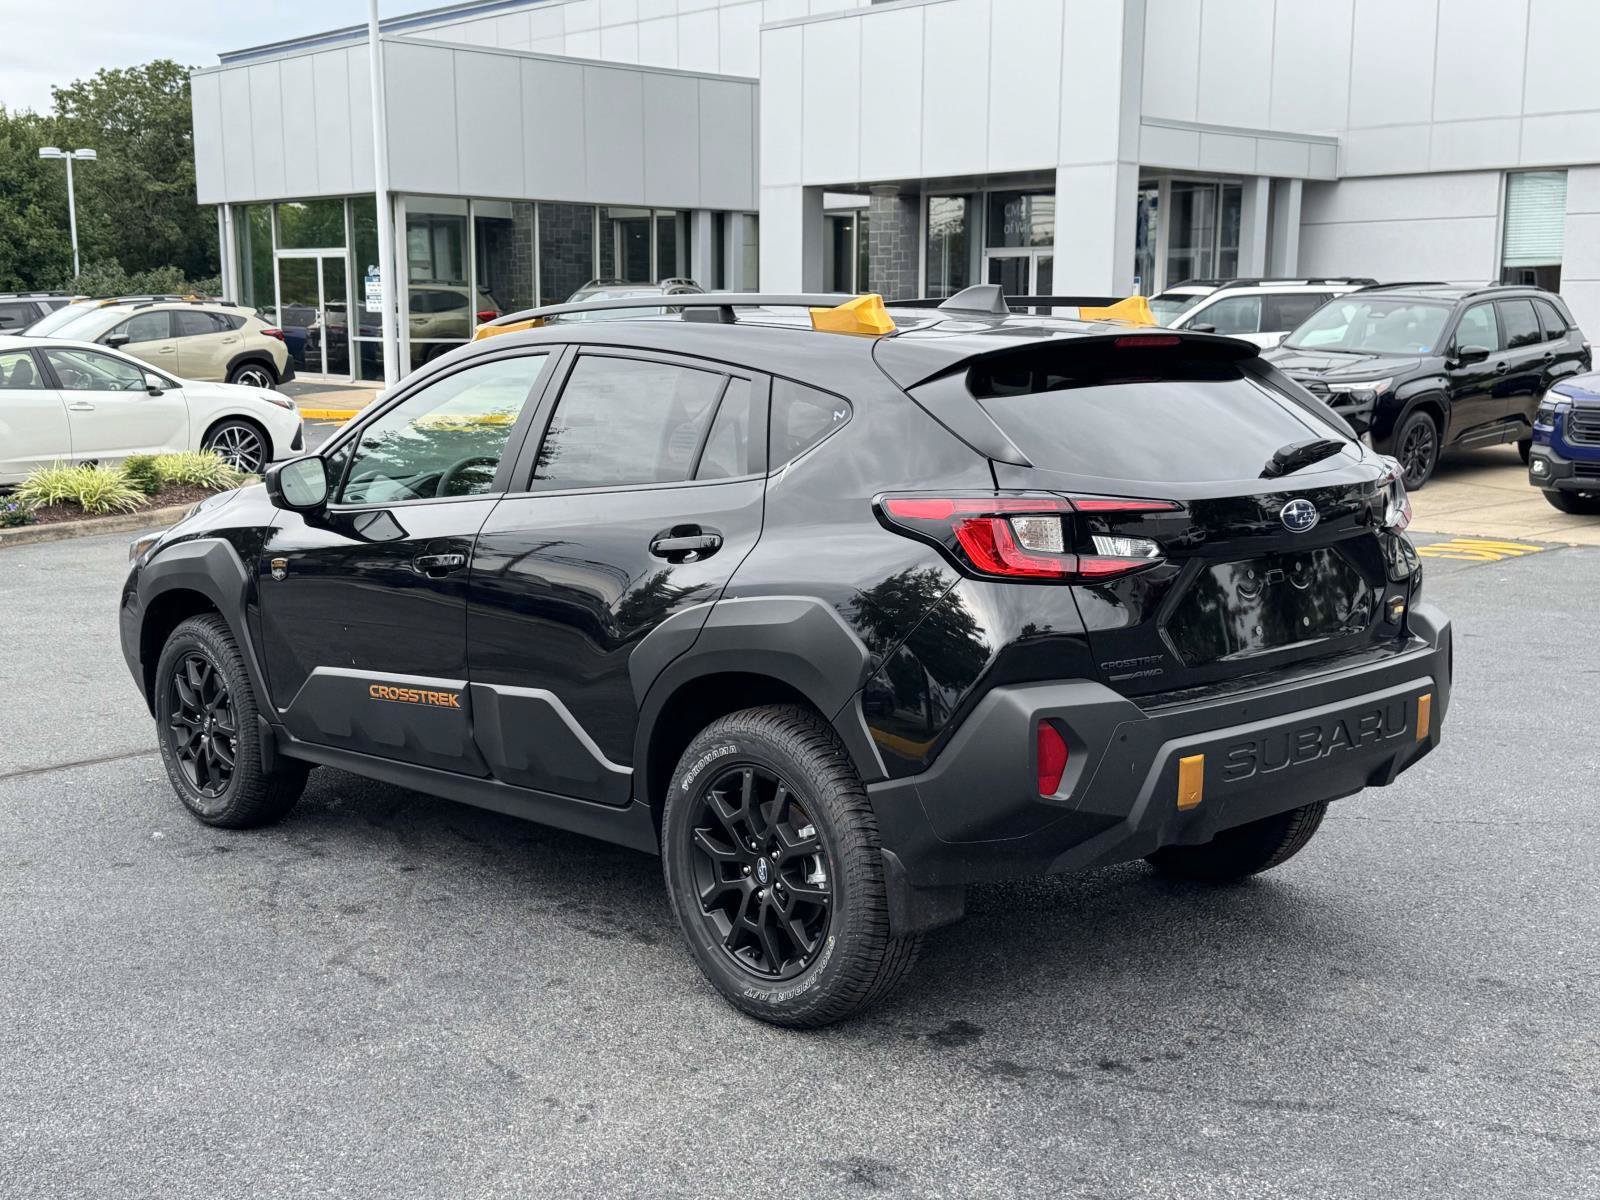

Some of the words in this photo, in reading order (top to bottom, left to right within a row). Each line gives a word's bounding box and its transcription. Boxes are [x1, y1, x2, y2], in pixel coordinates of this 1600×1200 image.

[1100, 654, 1164, 670] CROSSTREK
[369, 684, 461, 708] CROSSTREK
[1223, 701, 1408, 783] SUBARU
[681, 744, 737, 791] YOKOHAMA
[777, 935, 836, 1002] GEOLANDAR
[743, 988, 770, 1001] A/T
